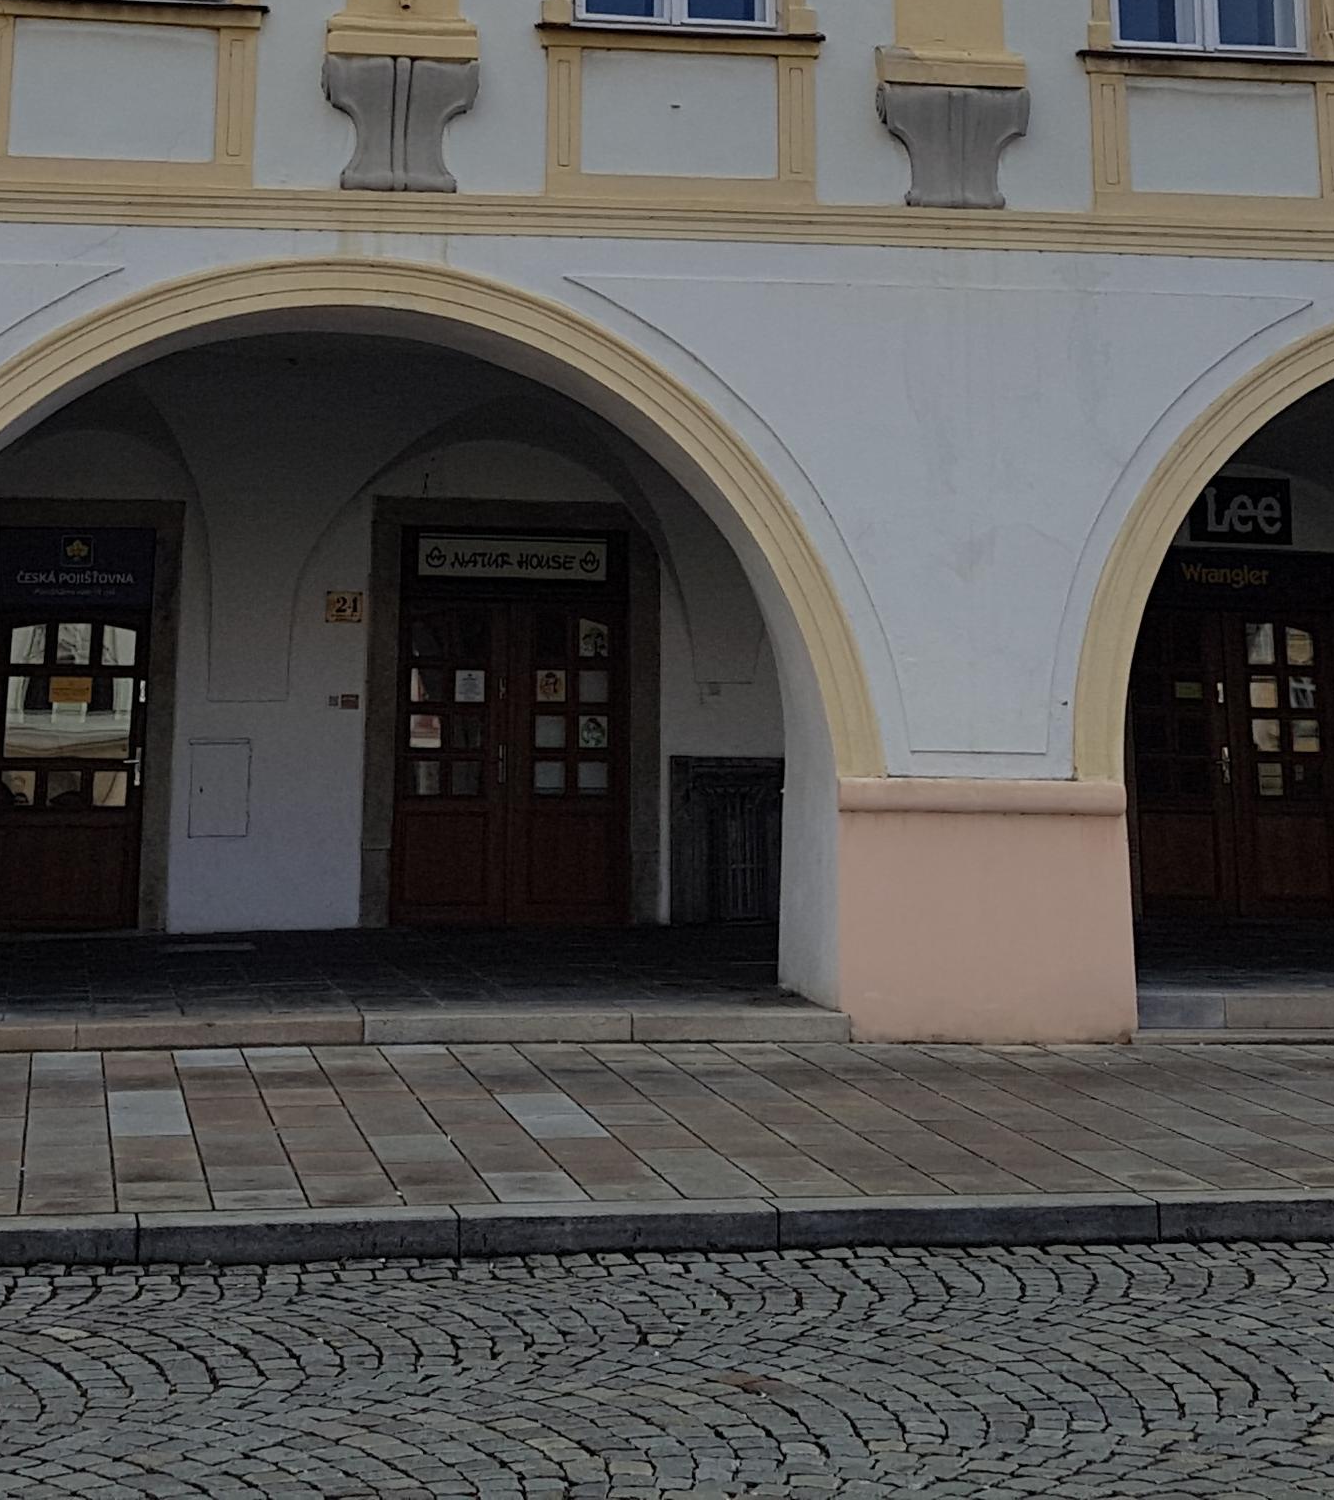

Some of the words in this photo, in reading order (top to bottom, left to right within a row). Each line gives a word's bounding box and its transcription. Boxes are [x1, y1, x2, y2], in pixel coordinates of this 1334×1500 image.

[1204, 486, 1282, 535] Lee
[450, 551, 514, 569] NATUR
[517, 552, 576, 570] HOUSE
[16, 569, 57, 584] ČESKÁ
[59, 569, 135, 585] POJIŠŤOVNA
[1180, 562, 1270, 588] Wrangler
